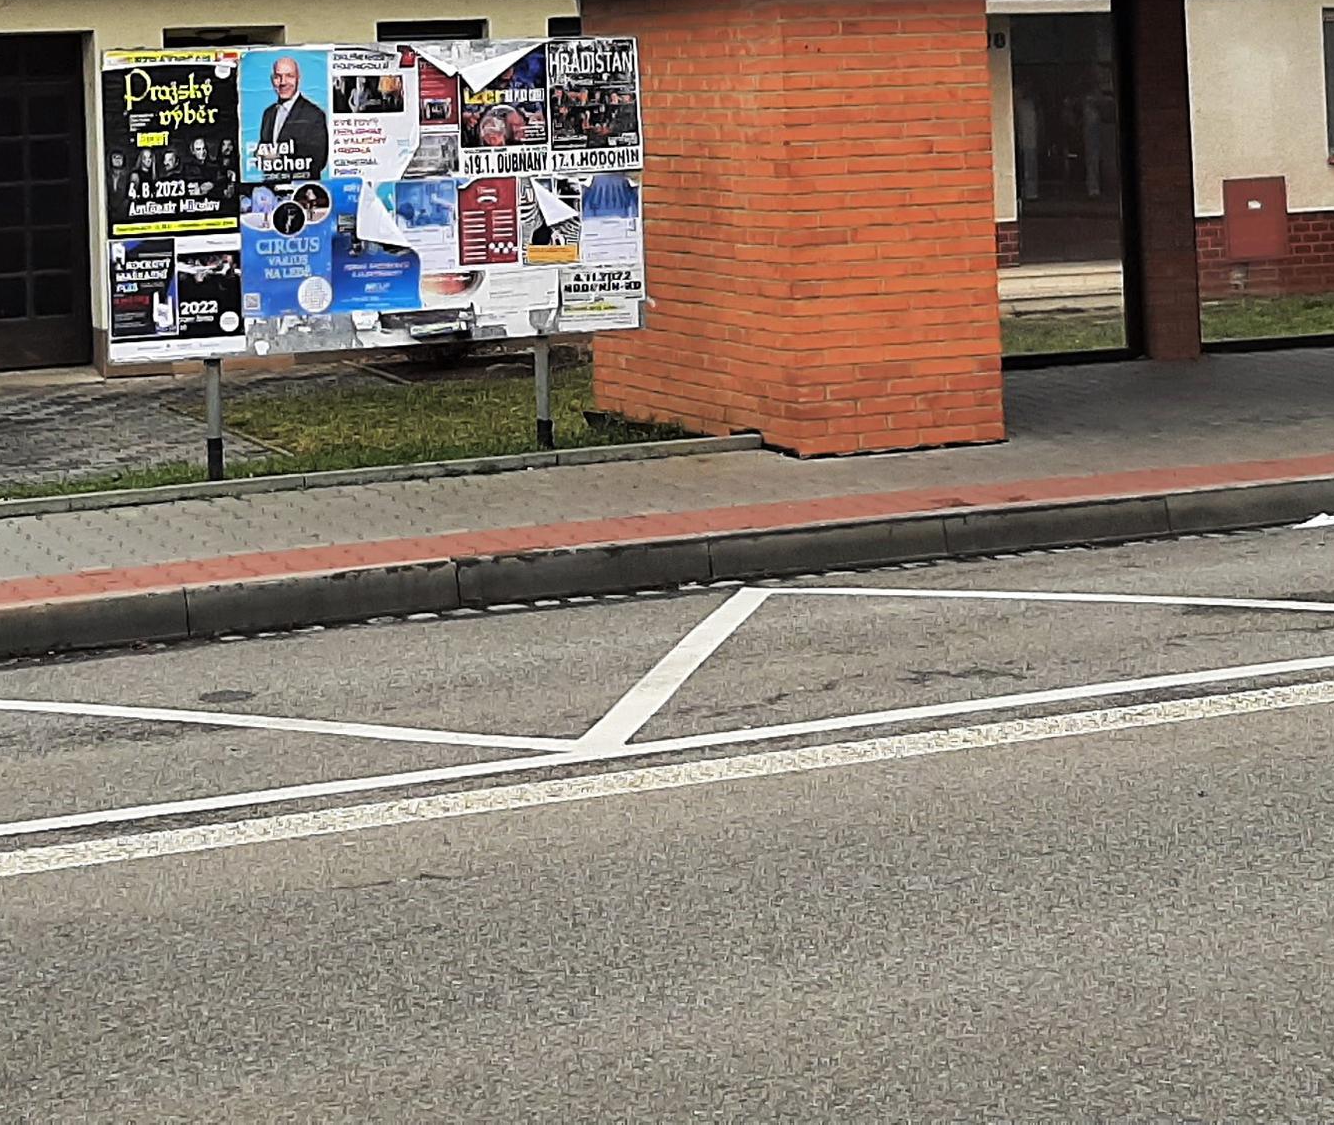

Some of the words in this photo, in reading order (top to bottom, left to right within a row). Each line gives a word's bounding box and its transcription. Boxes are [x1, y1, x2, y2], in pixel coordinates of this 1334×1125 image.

[159, 101, 218, 130] výběr
[247, 139, 294, 156] Pavel
[247, 155, 312, 171] Fischer
[256, 237, 319, 254] CIRCUS
[180, 301, 218, 315] 2022
